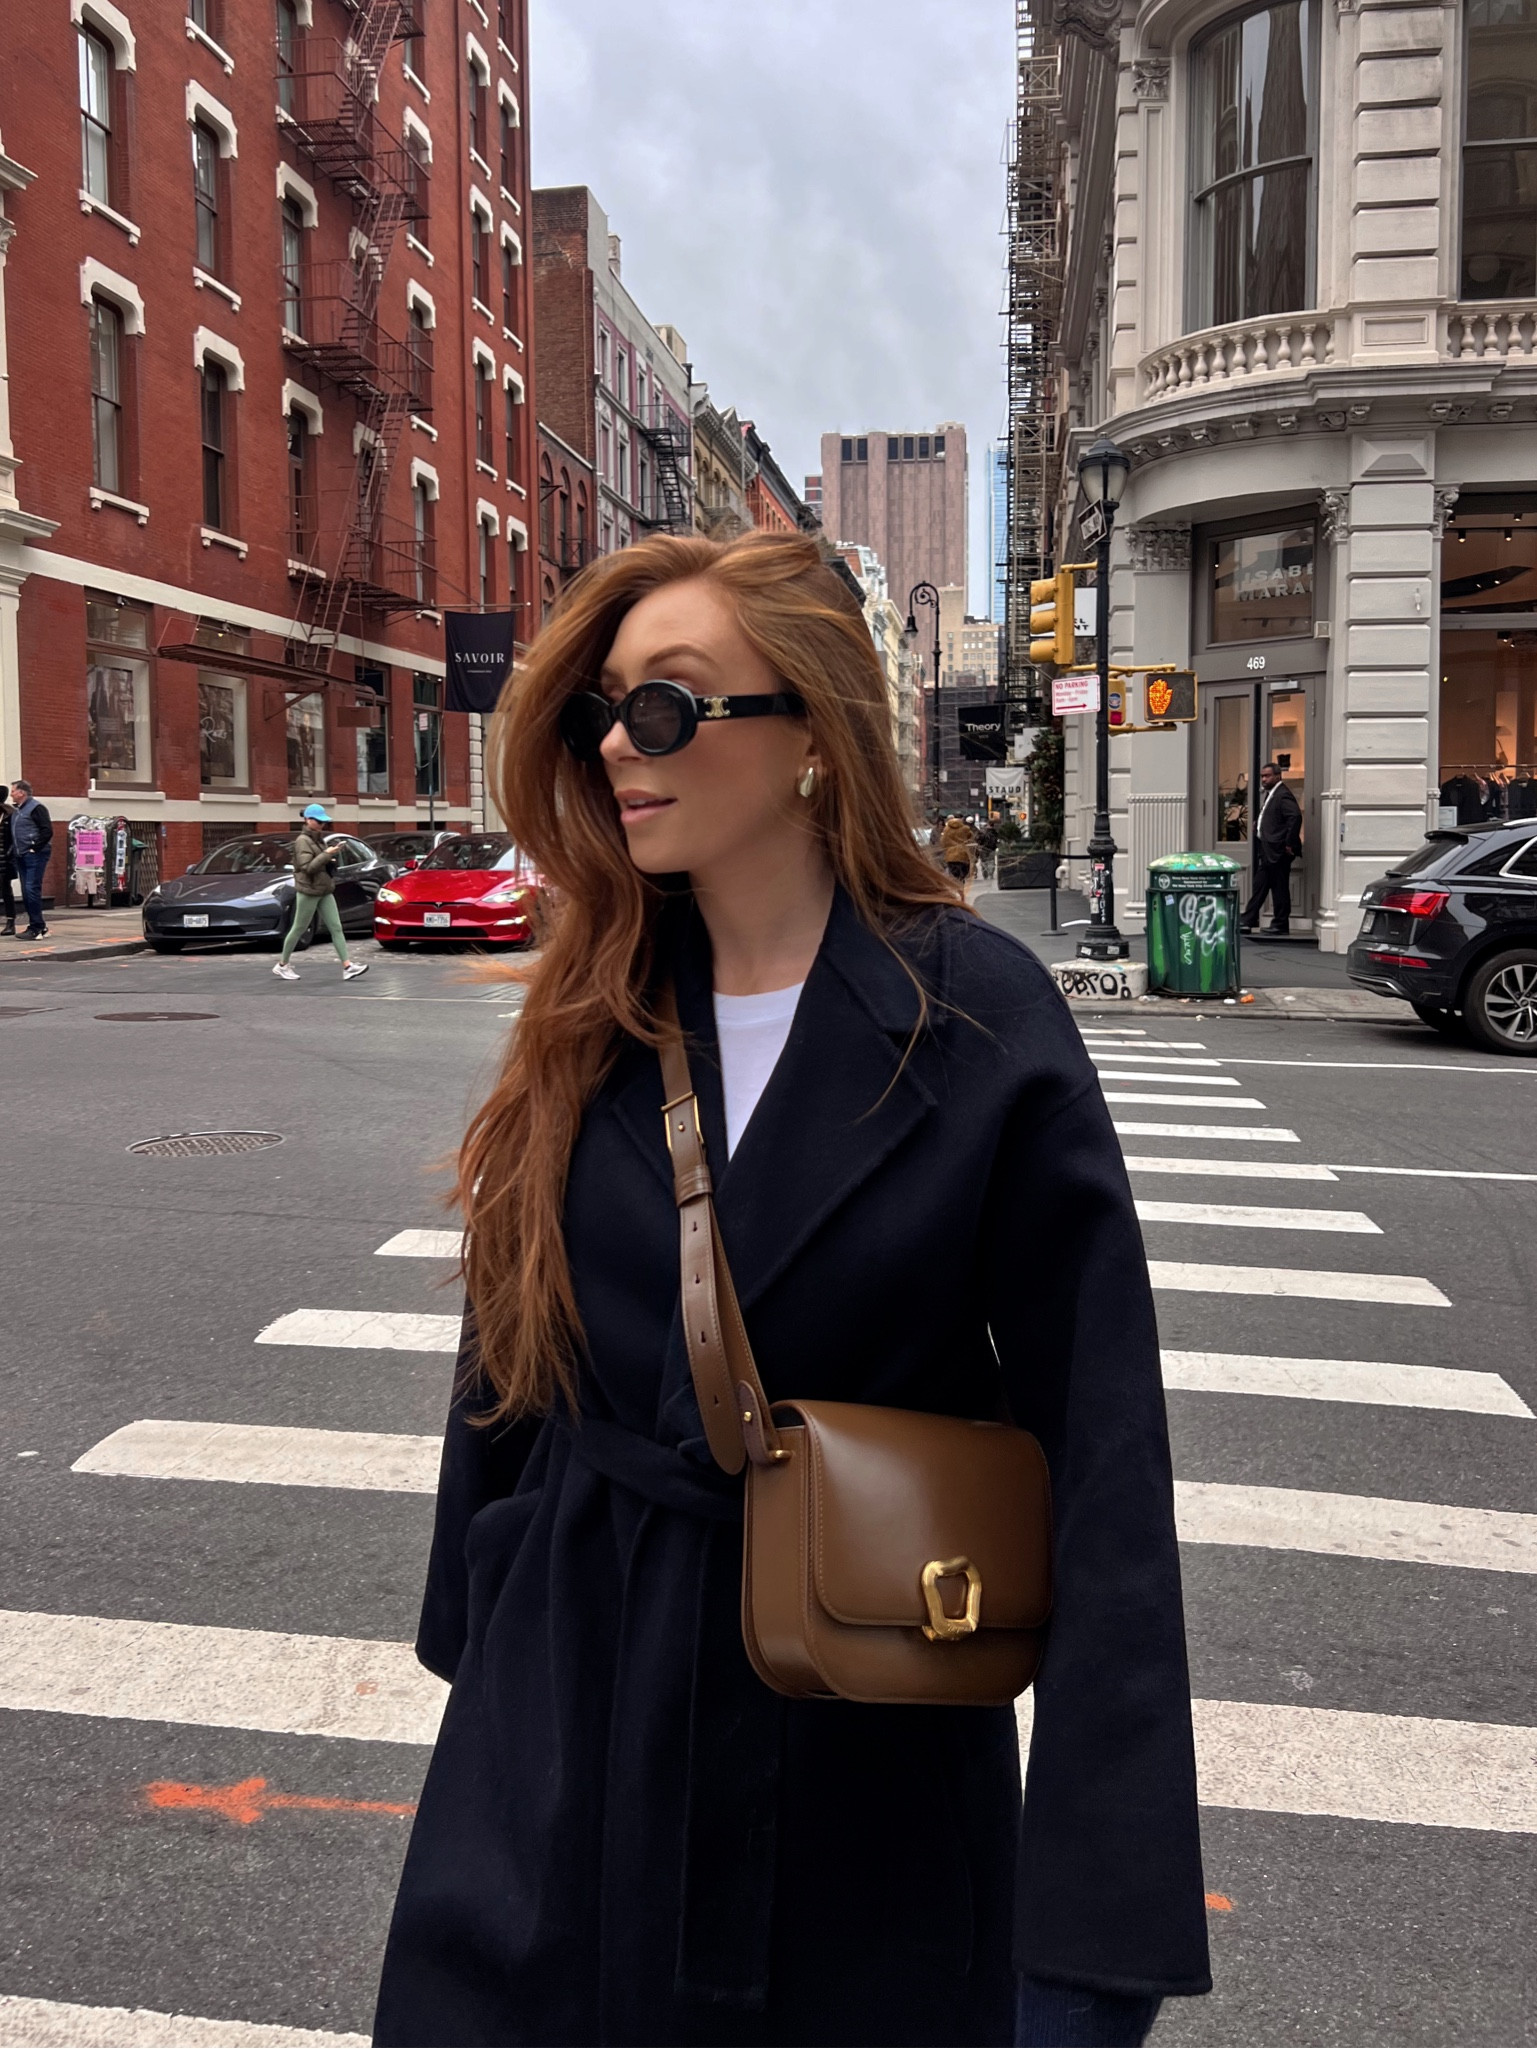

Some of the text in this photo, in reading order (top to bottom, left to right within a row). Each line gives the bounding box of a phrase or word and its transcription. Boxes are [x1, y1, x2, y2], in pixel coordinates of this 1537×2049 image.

[1240, 580, 1313, 600] MARA
[455, 652, 505, 663] SAVOIR
[1246, 656, 1265, 670] 469
[965, 723, 1001, 732] Theory
[989, 786, 1021, 794] STAUD
